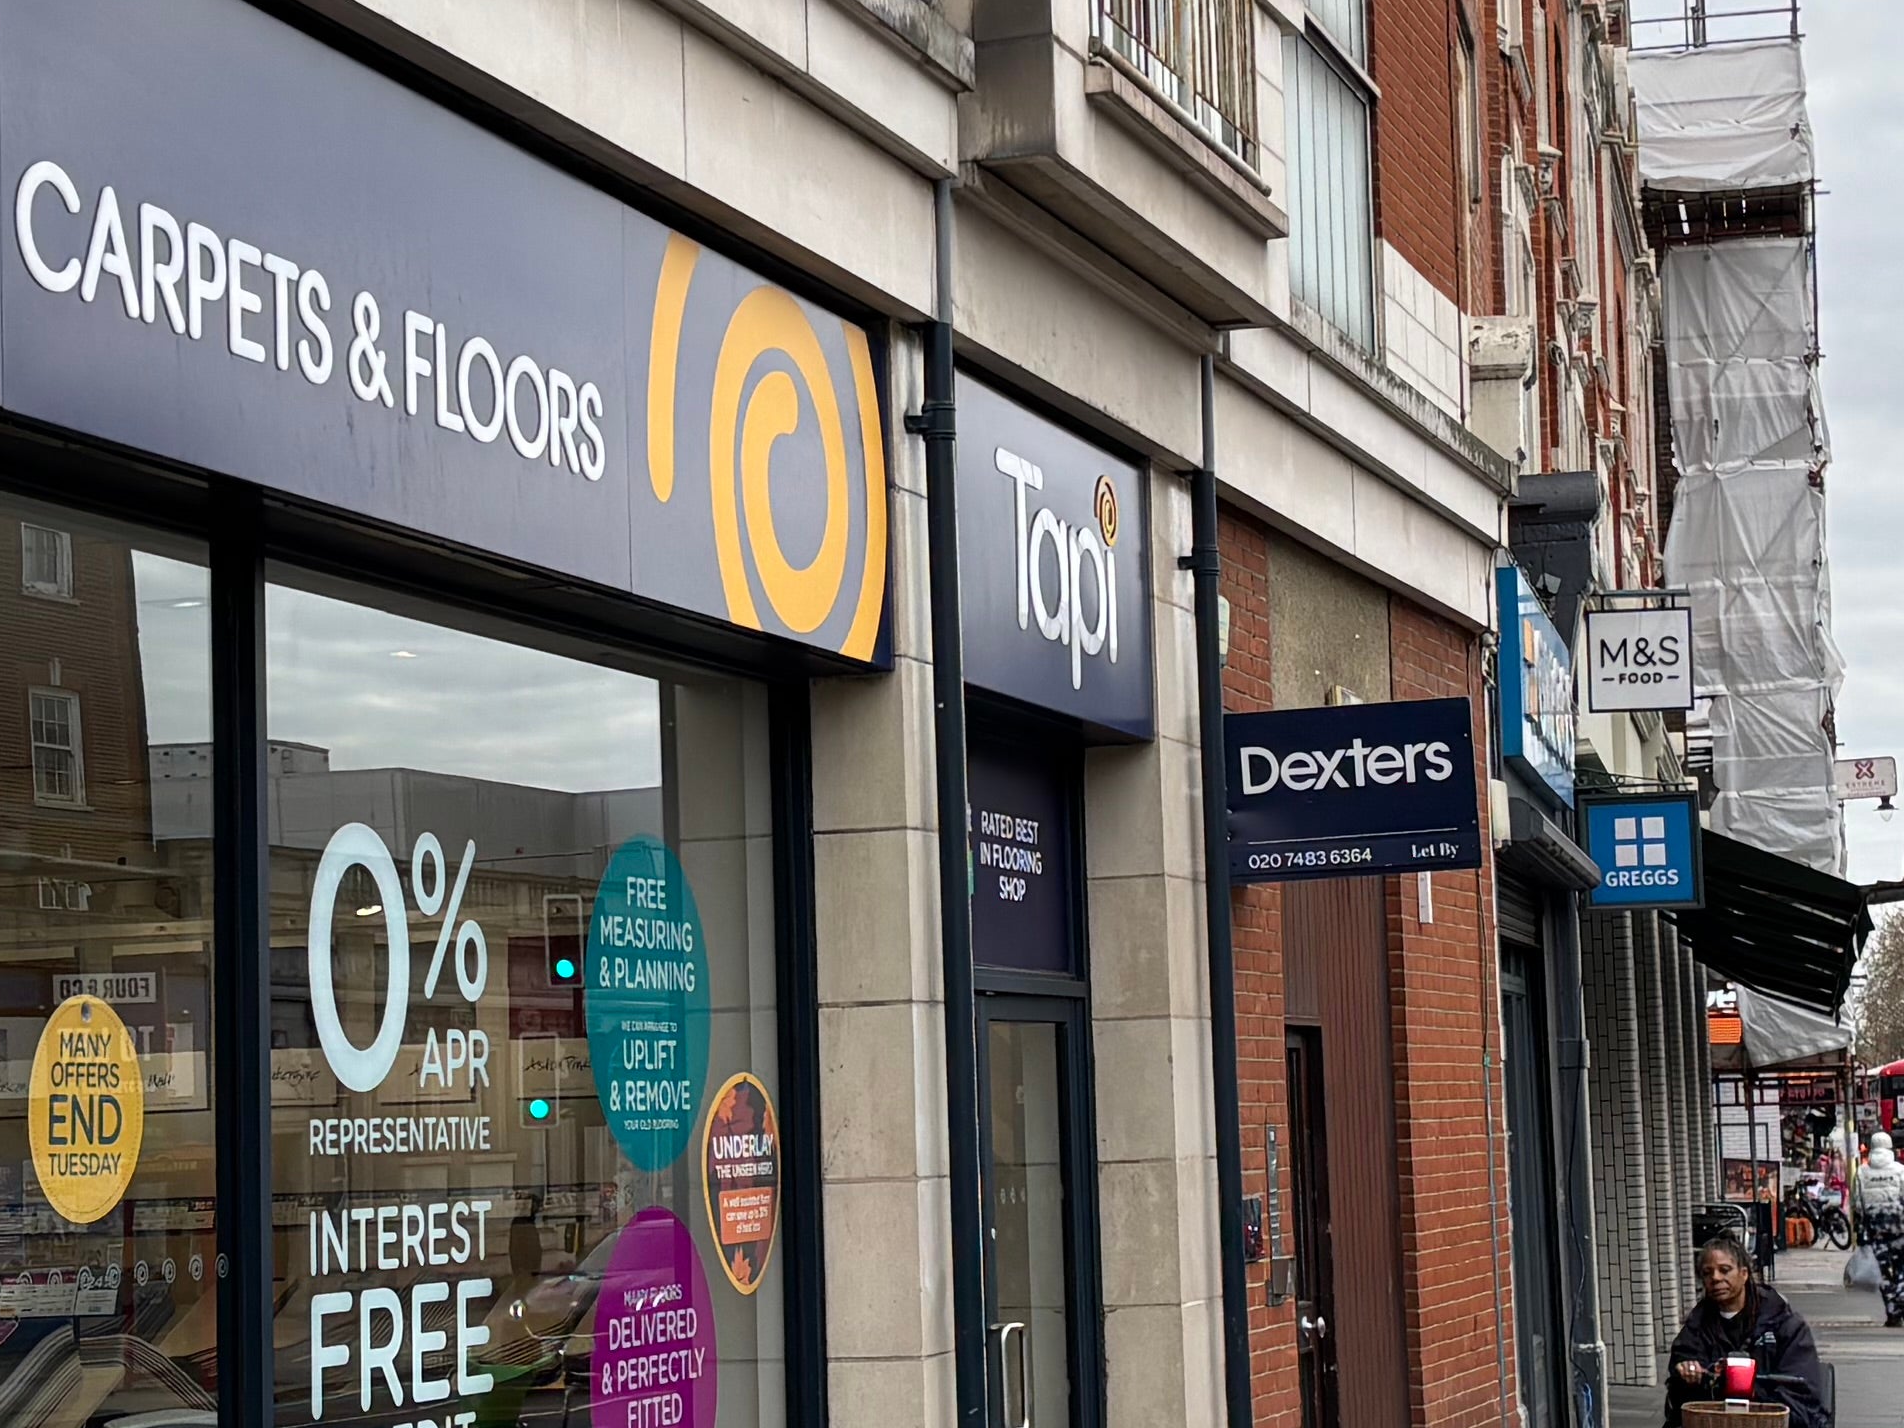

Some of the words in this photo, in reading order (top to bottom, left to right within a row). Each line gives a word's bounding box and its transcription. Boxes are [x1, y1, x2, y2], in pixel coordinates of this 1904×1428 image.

[15, 160, 333, 385] CARPETS
[348, 291, 394, 408] &
[404, 309, 606, 482] FLOORS
[994, 446, 1118, 691] Tapi
[1600, 635, 1680, 669] M&S
[1618, 671, 1663, 684] FOOD
[1239, 738, 1453, 796] Dexters
[981, 810, 1013, 840] RATED
[1015, 817, 1039, 845] BEST
[980, 842, 991, 866] IN
[993, 844, 1042, 875] FLOORING
[1248, 854, 1281, 869] 020
[1284, 851, 1328, 867] 7483
[1330, 847, 1372, 865] 6364
[1411, 844, 1436, 859] Let
[1439, 842, 1459, 861] By
[627, 876, 666, 910] FREE
[999, 875, 1026, 902] SHOP
[1605, 869, 1679, 887] GREGGS
[600, 915, 693, 953] MEASURING
[308, 821, 488, 1093] 0%
[599, 955, 611, 988] &
[614, 957, 695, 993] PLANNING
[59, 1031, 111, 1059] MANY
[420, 1027, 489, 1088] APR
[623, 1039, 677, 1070] UPLIFT
[51, 1062, 120, 1088] OFFERS
[610, 1080, 621, 1112] &
[625, 1080, 691, 1112] REMOVE
[48, 1094, 122, 1146] END
[309, 1116, 491, 1155] REPRESENTATIVE
[712, 1133, 774, 1160] UNDERLAY
[48, 1153, 122, 1177] TUESDAY
[715, 1164, 732, 1179] THE
[310, 1200, 492, 1276] INTEREST
[609, 1307, 697, 1351] DELIVERED
[311, 1278, 494, 1420] FREE
[601, 1362, 613, 1395] &
[617, 1347, 705, 1393] PERFECTLY
